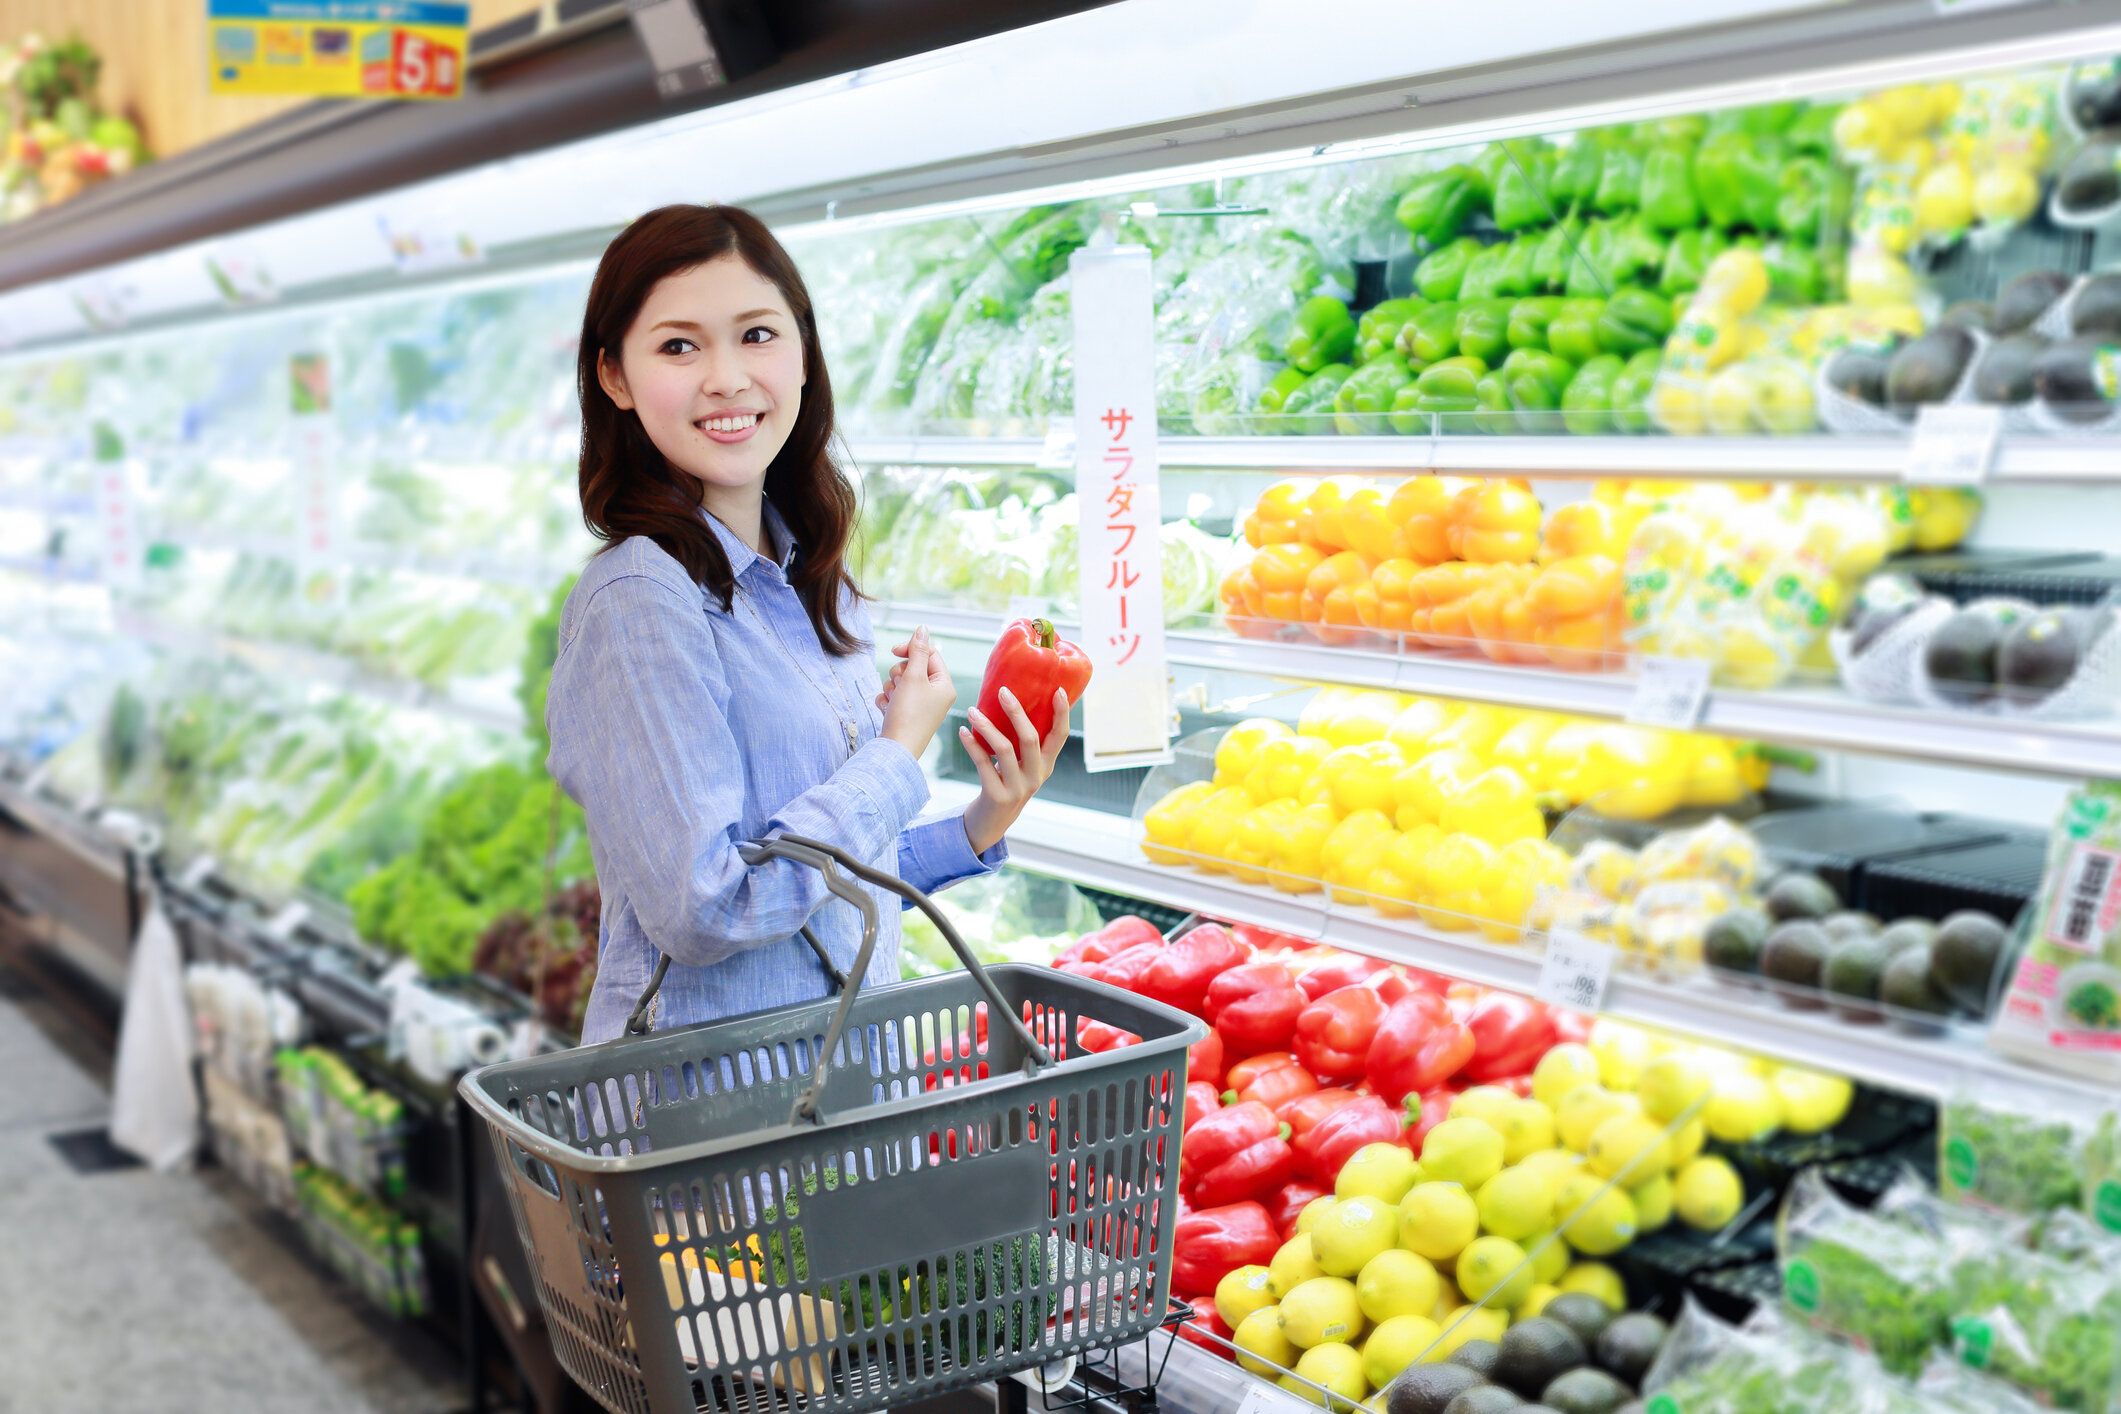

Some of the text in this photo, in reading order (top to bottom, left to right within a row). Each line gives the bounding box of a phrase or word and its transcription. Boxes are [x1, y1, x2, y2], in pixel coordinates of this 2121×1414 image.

[1100, 408, 1141, 666] サラダフルーツ
[1574, 975, 1596, 995] 198
